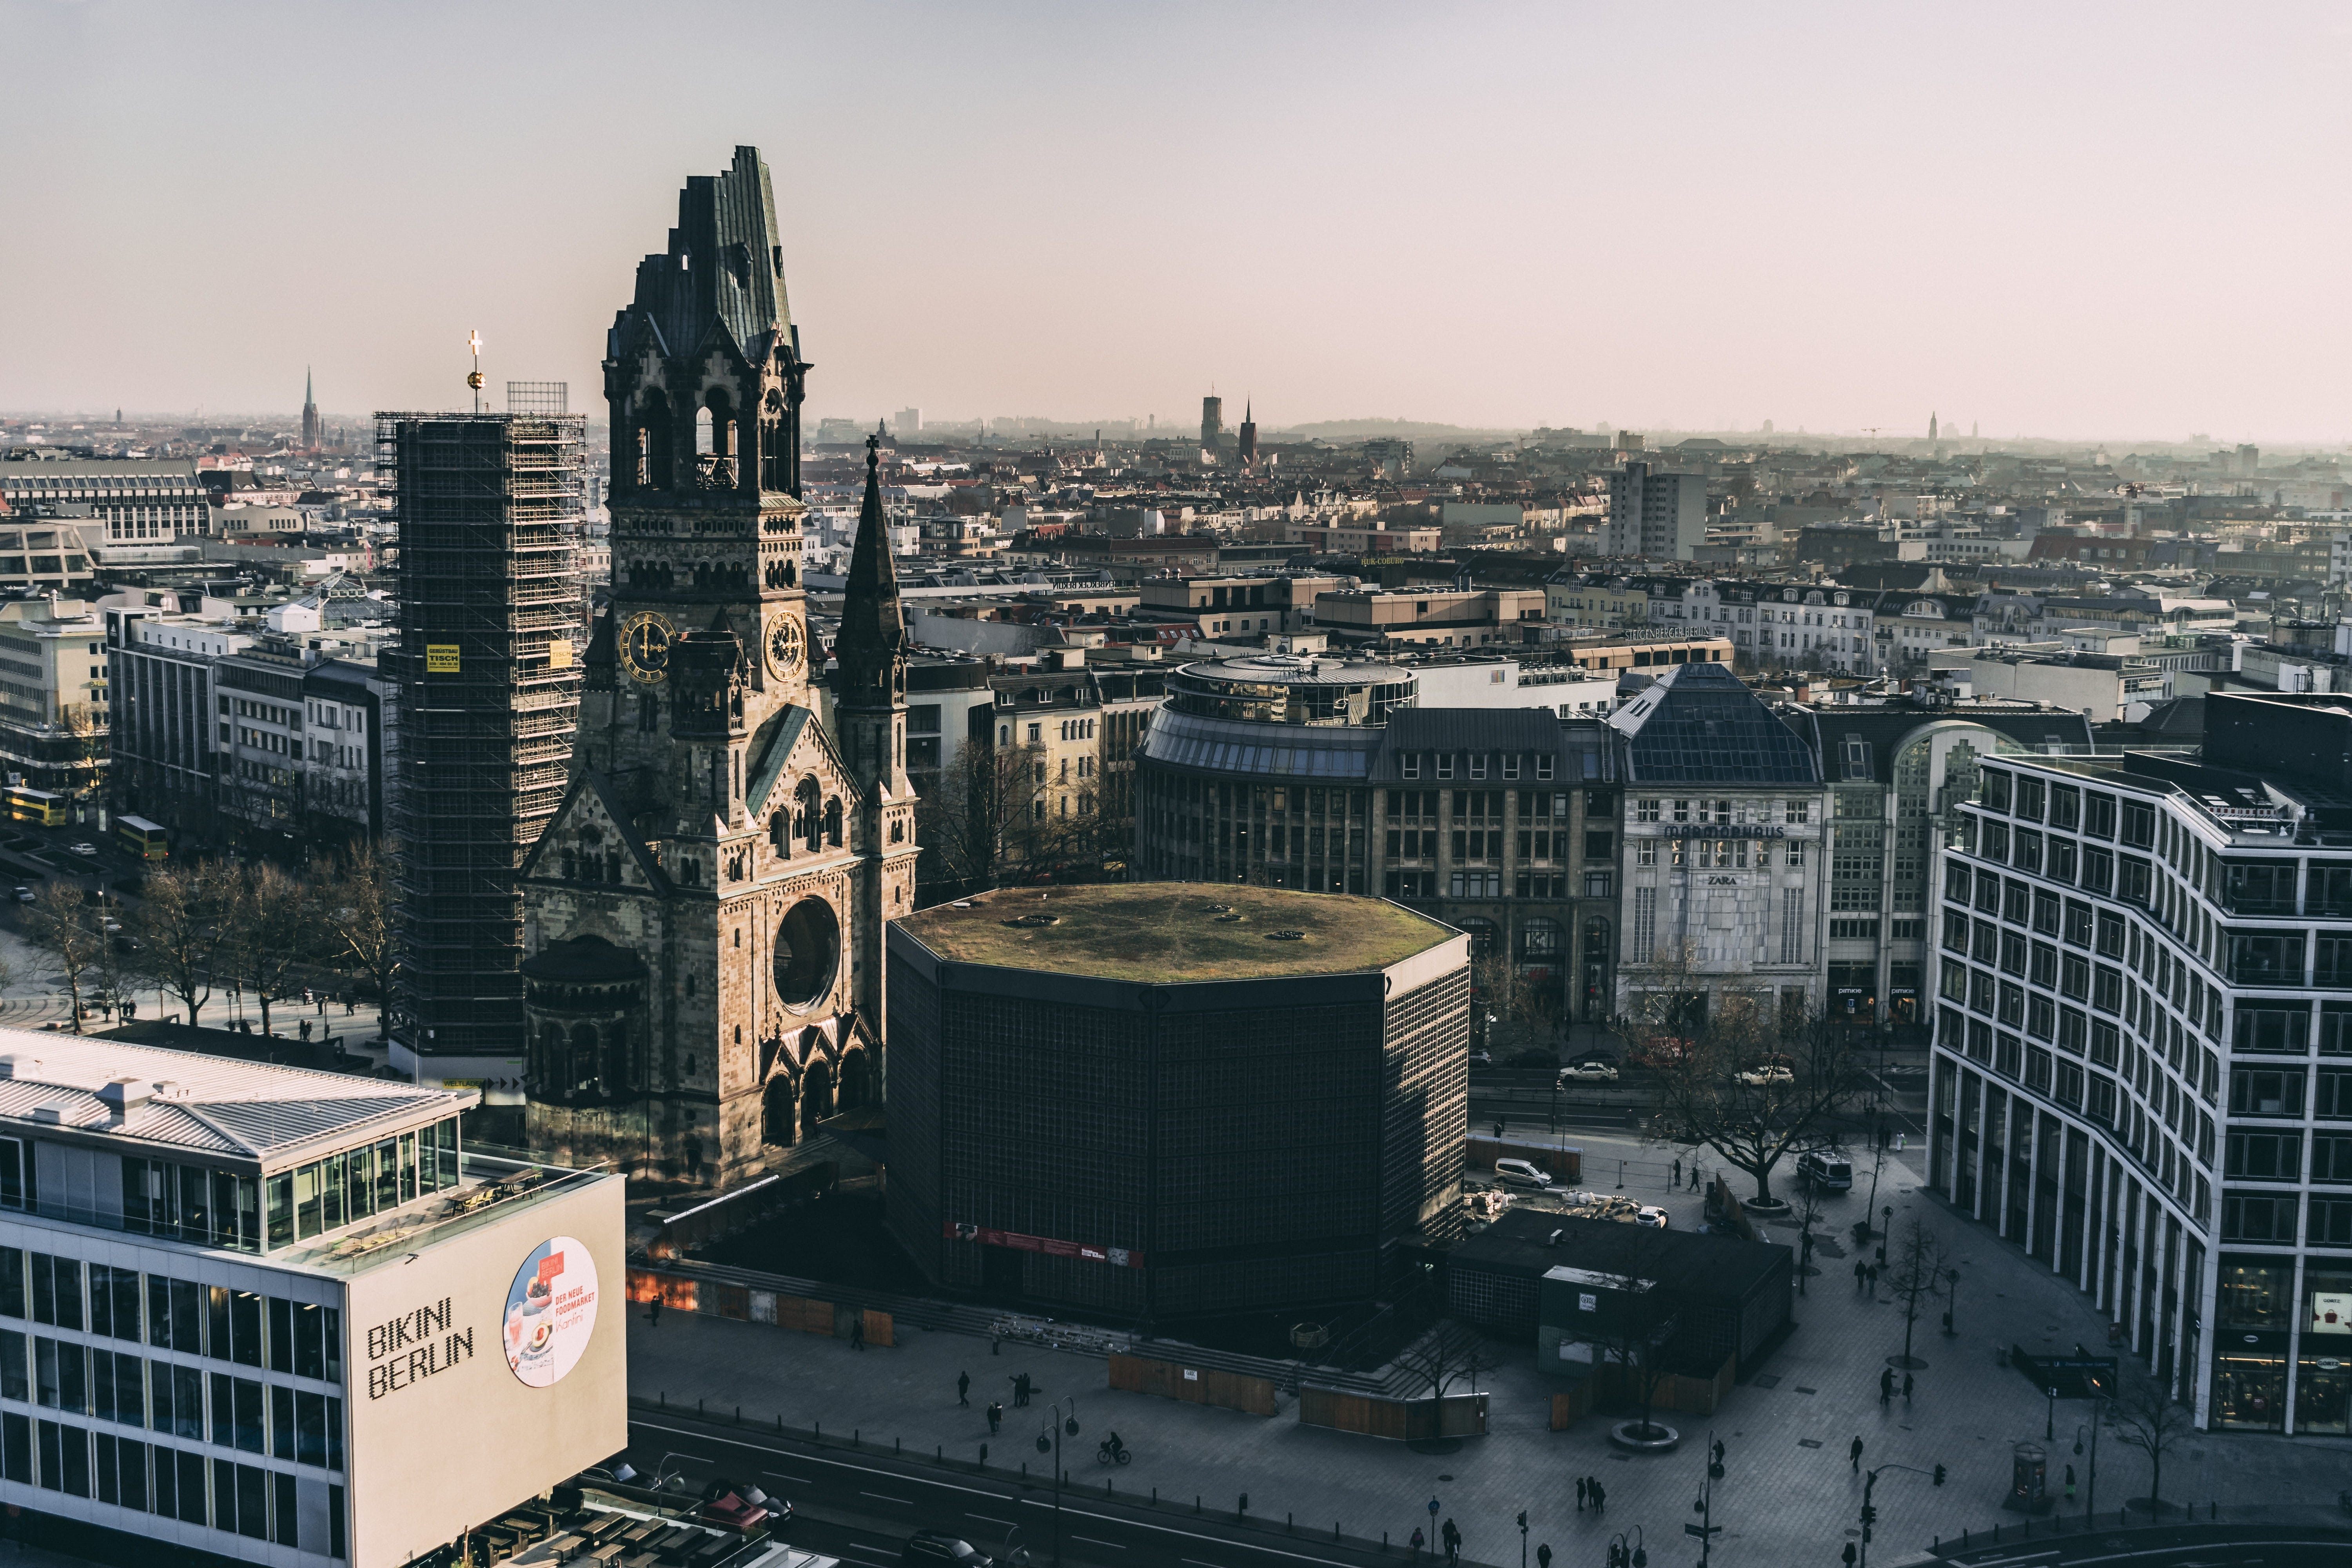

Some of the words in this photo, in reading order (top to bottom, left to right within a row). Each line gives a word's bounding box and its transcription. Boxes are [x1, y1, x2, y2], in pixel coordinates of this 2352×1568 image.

[1625, 626, 1709, 640] STEIGENBERGER-BERLIN
[1664, 822, 1784, 838] MARMORHAUS
[1708, 877, 1737, 885] ZARA
[541, 1256, 558, 1270] BIKINI
[542, 1264, 563, 1278] BERLIN
[556, 1293, 567, 1305] DER
[568, 1285, 583, 1299] NEUE
[556, 1292, 595, 1317] FOODMARKET
[368, 1297, 451, 1361] BIKINI
[556, 1309, 583, 1333] Kantini
[369, 1327, 473, 1401] BERLIN
